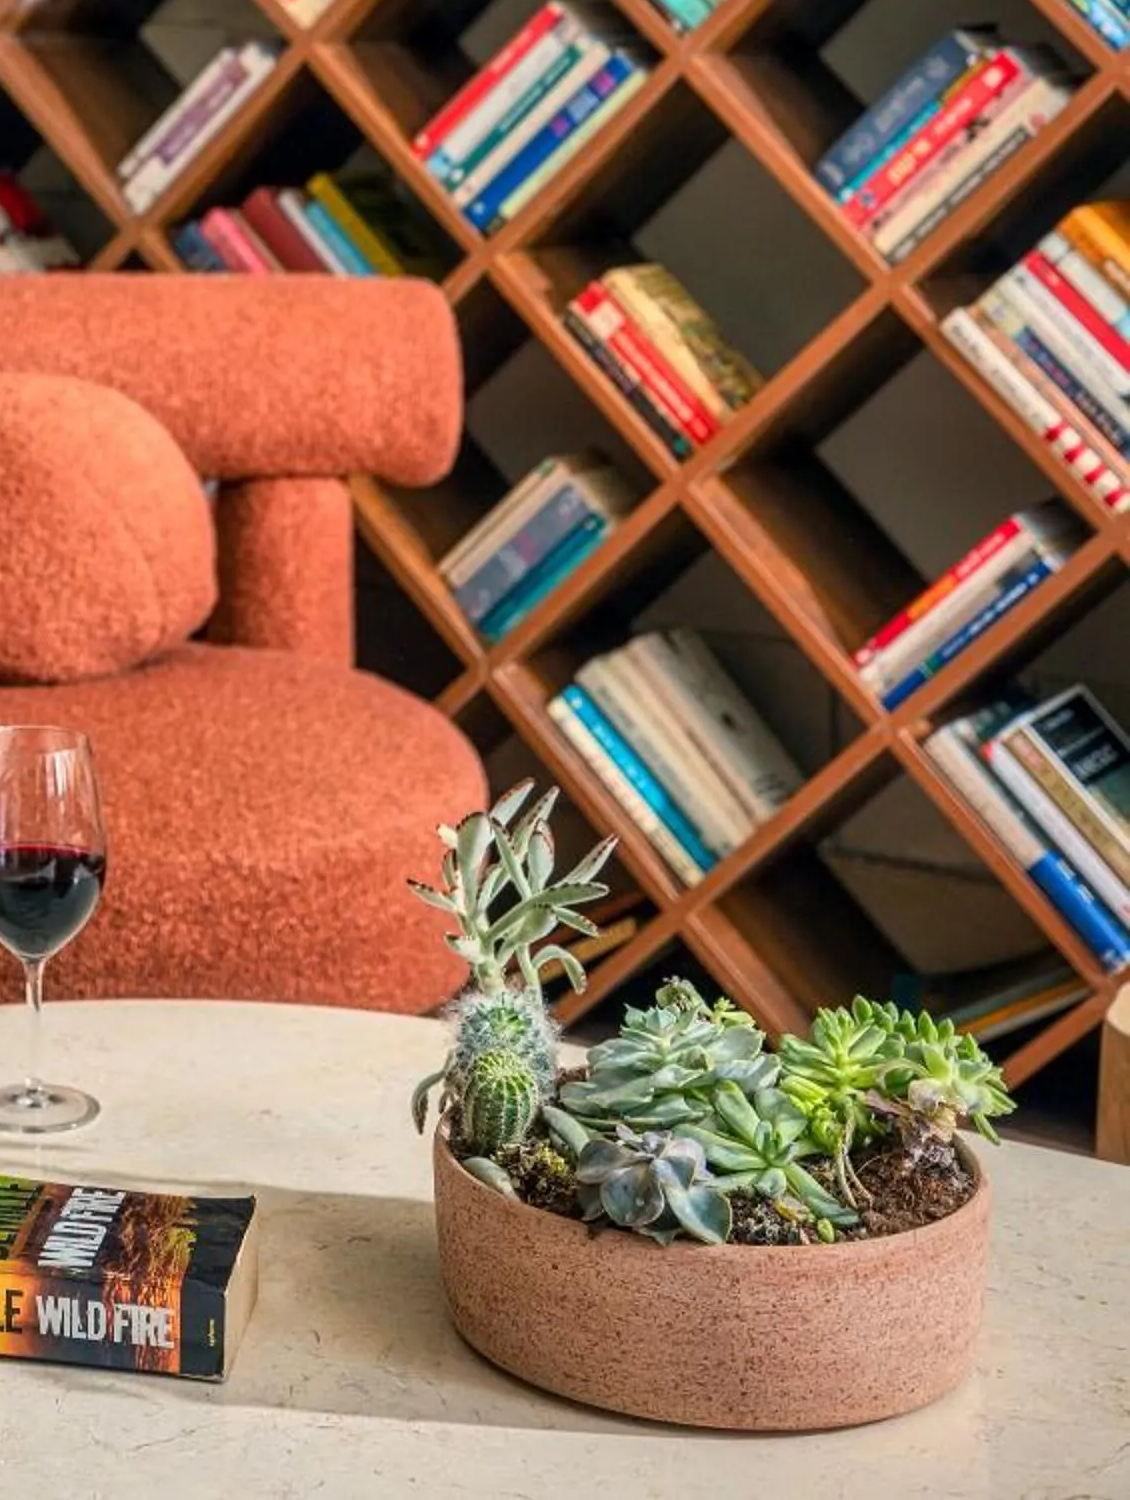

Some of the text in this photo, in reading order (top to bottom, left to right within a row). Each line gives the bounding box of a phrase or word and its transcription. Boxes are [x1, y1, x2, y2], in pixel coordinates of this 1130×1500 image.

[37, 1187, 127, 1267] WILD FIRE
[36, 1295, 107, 1342] WILD
[113, 1304, 175, 1350] FIRE
